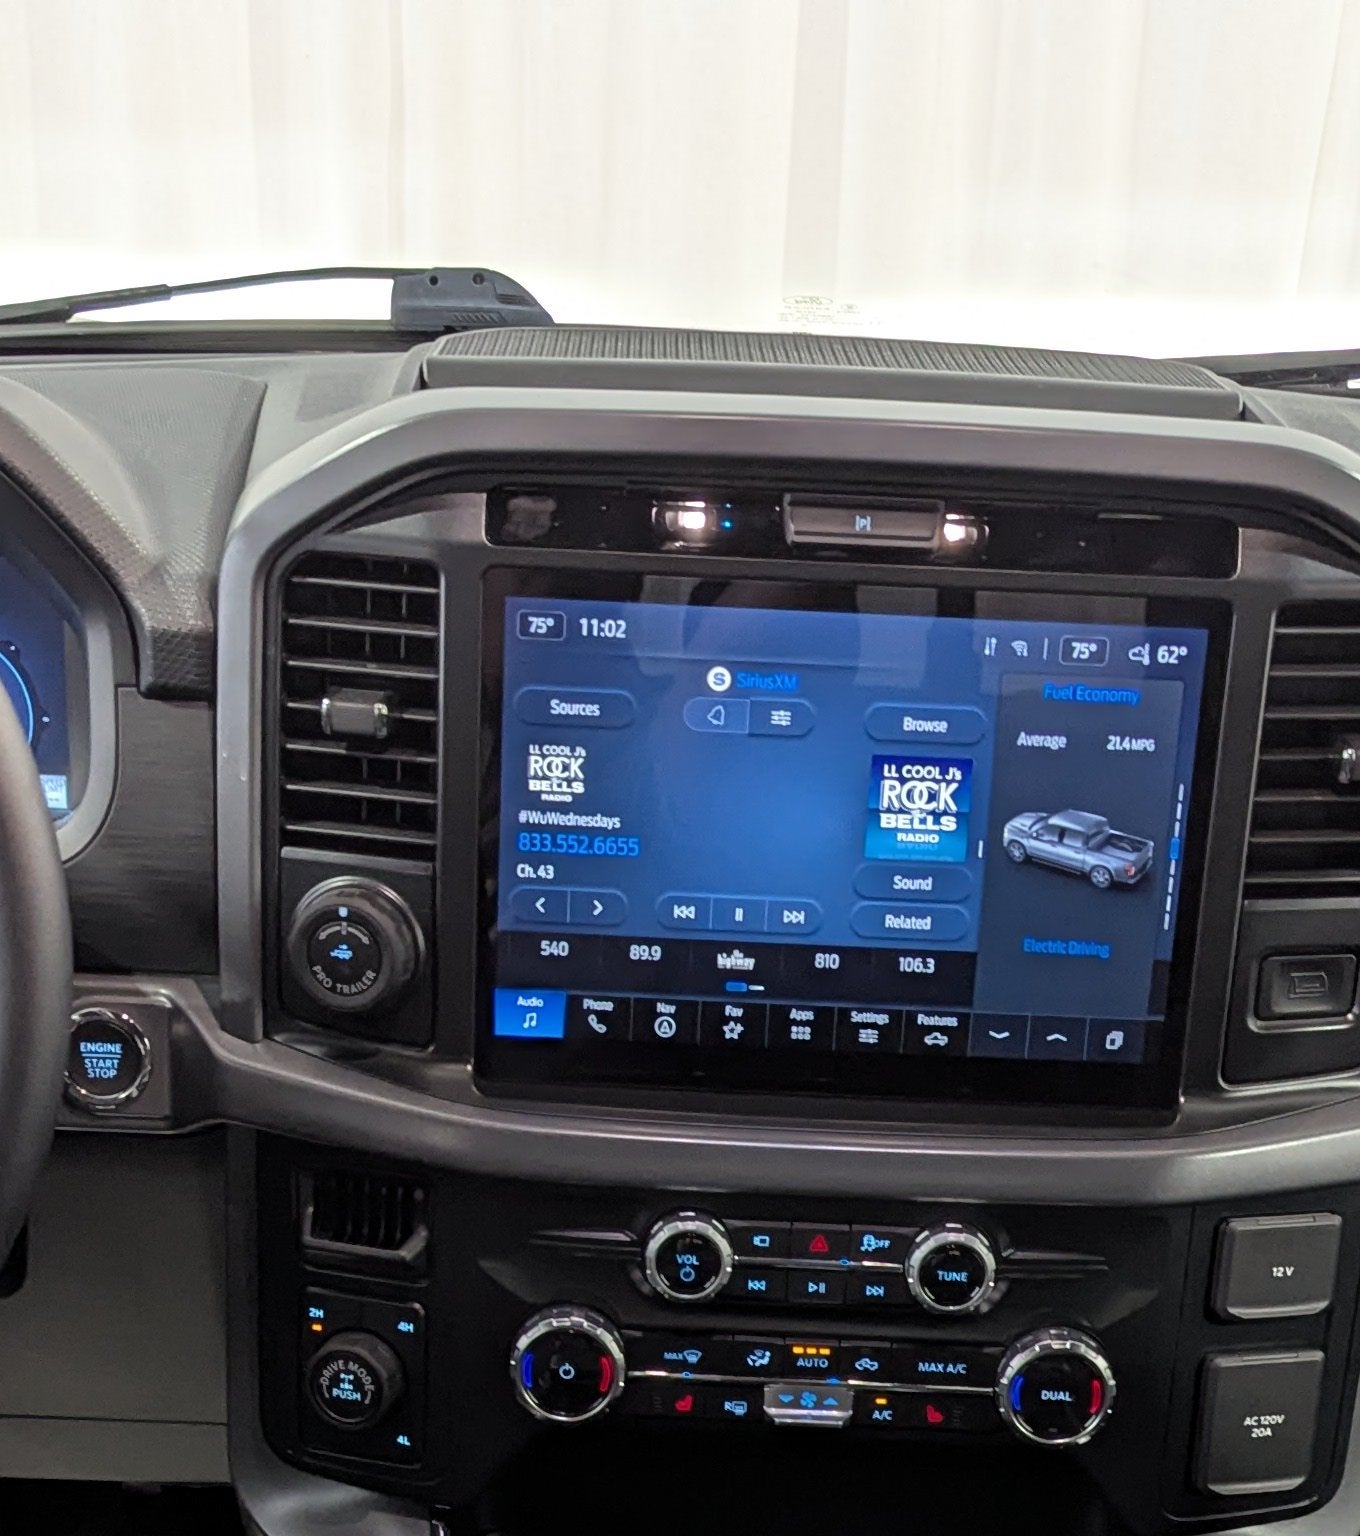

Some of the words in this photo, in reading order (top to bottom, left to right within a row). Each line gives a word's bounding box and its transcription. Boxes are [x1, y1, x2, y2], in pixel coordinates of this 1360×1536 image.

[579, 617, 627, 638] 11:02
[736, 672, 798, 690] SiriusXM
[1043, 684, 1074, 700] Fuel
[1076, 686, 1139, 707] Economy
[550, 699, 601, 717] Sources
[903, 716, 949, 733] Browse
[1017, 732, 1067, 750] Average
[529, 744, 541, 755] LL
[542, 745, 572, 756] COOL
[528, 755, 585, 779] ROCK
[883, 764, 899, 778] LL
[902, 765, 942, 780] COOL
[945, 767, 962, 781] J's
[528, 779, 585, 793] BELLS
[541, 793, 573, 802] RADIO
[880, 779, 959, 813] ROCK
[518, 810, 621, 830] #WuWednesdays
[879, 812, 957, 832] BELLS
[518, 832, 639, 857] 833.552.6655
[896, 832, 940, 843] RADIO
[537, 864, 555, 879] 43
[893, 875, 933, 891] Sound
[885, 914, 931, 930] Related
[540, 940, 569, 957] 540
[629, 944, 661, 961] 89.9
[1023, 937, 1066, 954] Electric
[1068, 940, 1110, 959] Driving
[815, 952, 840, 970] 810
[898, 956, 935, 974] 106.3
[312, 965, 333, 988] PRO
[335, 969, 377, 994] TRAILER
[517, 995, 544, 1008] Audio
[583, 999, 614, 1012] Phone
[656, 1002, 676, 1015] Nav
[724, 1005, 743, 1018] Fav
[789, 1008, 814, 1022] Apps
[850, 1010, 889, 1025] Settings
[917, 1013, 958, 1028] Features
[79, 1041, 123, 1054] ENGINE
[84, 1058, 120, 1069] START
[87, 1069, 118, 1079] STOP
[875, 1239, 891, 1248] OFF
[676, 1253, 699, 1265] VOL
[937, 1270, 969, 1283] TUNE
[309, 1307, 324, 1319] 2H
[397, 1321, 415, 1334] 4H
[663, 1351, 684, 1361] MAX
[796, 1357, 829, 1369] AUTO
[918, 1362, 944, 1373] MAX
[946, 1362, 967, 1375] A/C
[320, 1359, 346, 1386] DRIVE
[347, 1360, 375, 1393] MODE
[332, 1387, 362, 1402] PUSH
[1041, 1389, 1072, 1402] DUAL
[872, 1409, 893, 1421] A/C
[1243, 1416, 1259, 1426] AC
[1260, 1414, 1285, 1425] 120V
[1251, 1427, 1272, 1438] 20A
[396, 1434, 411, 1446] 4L
